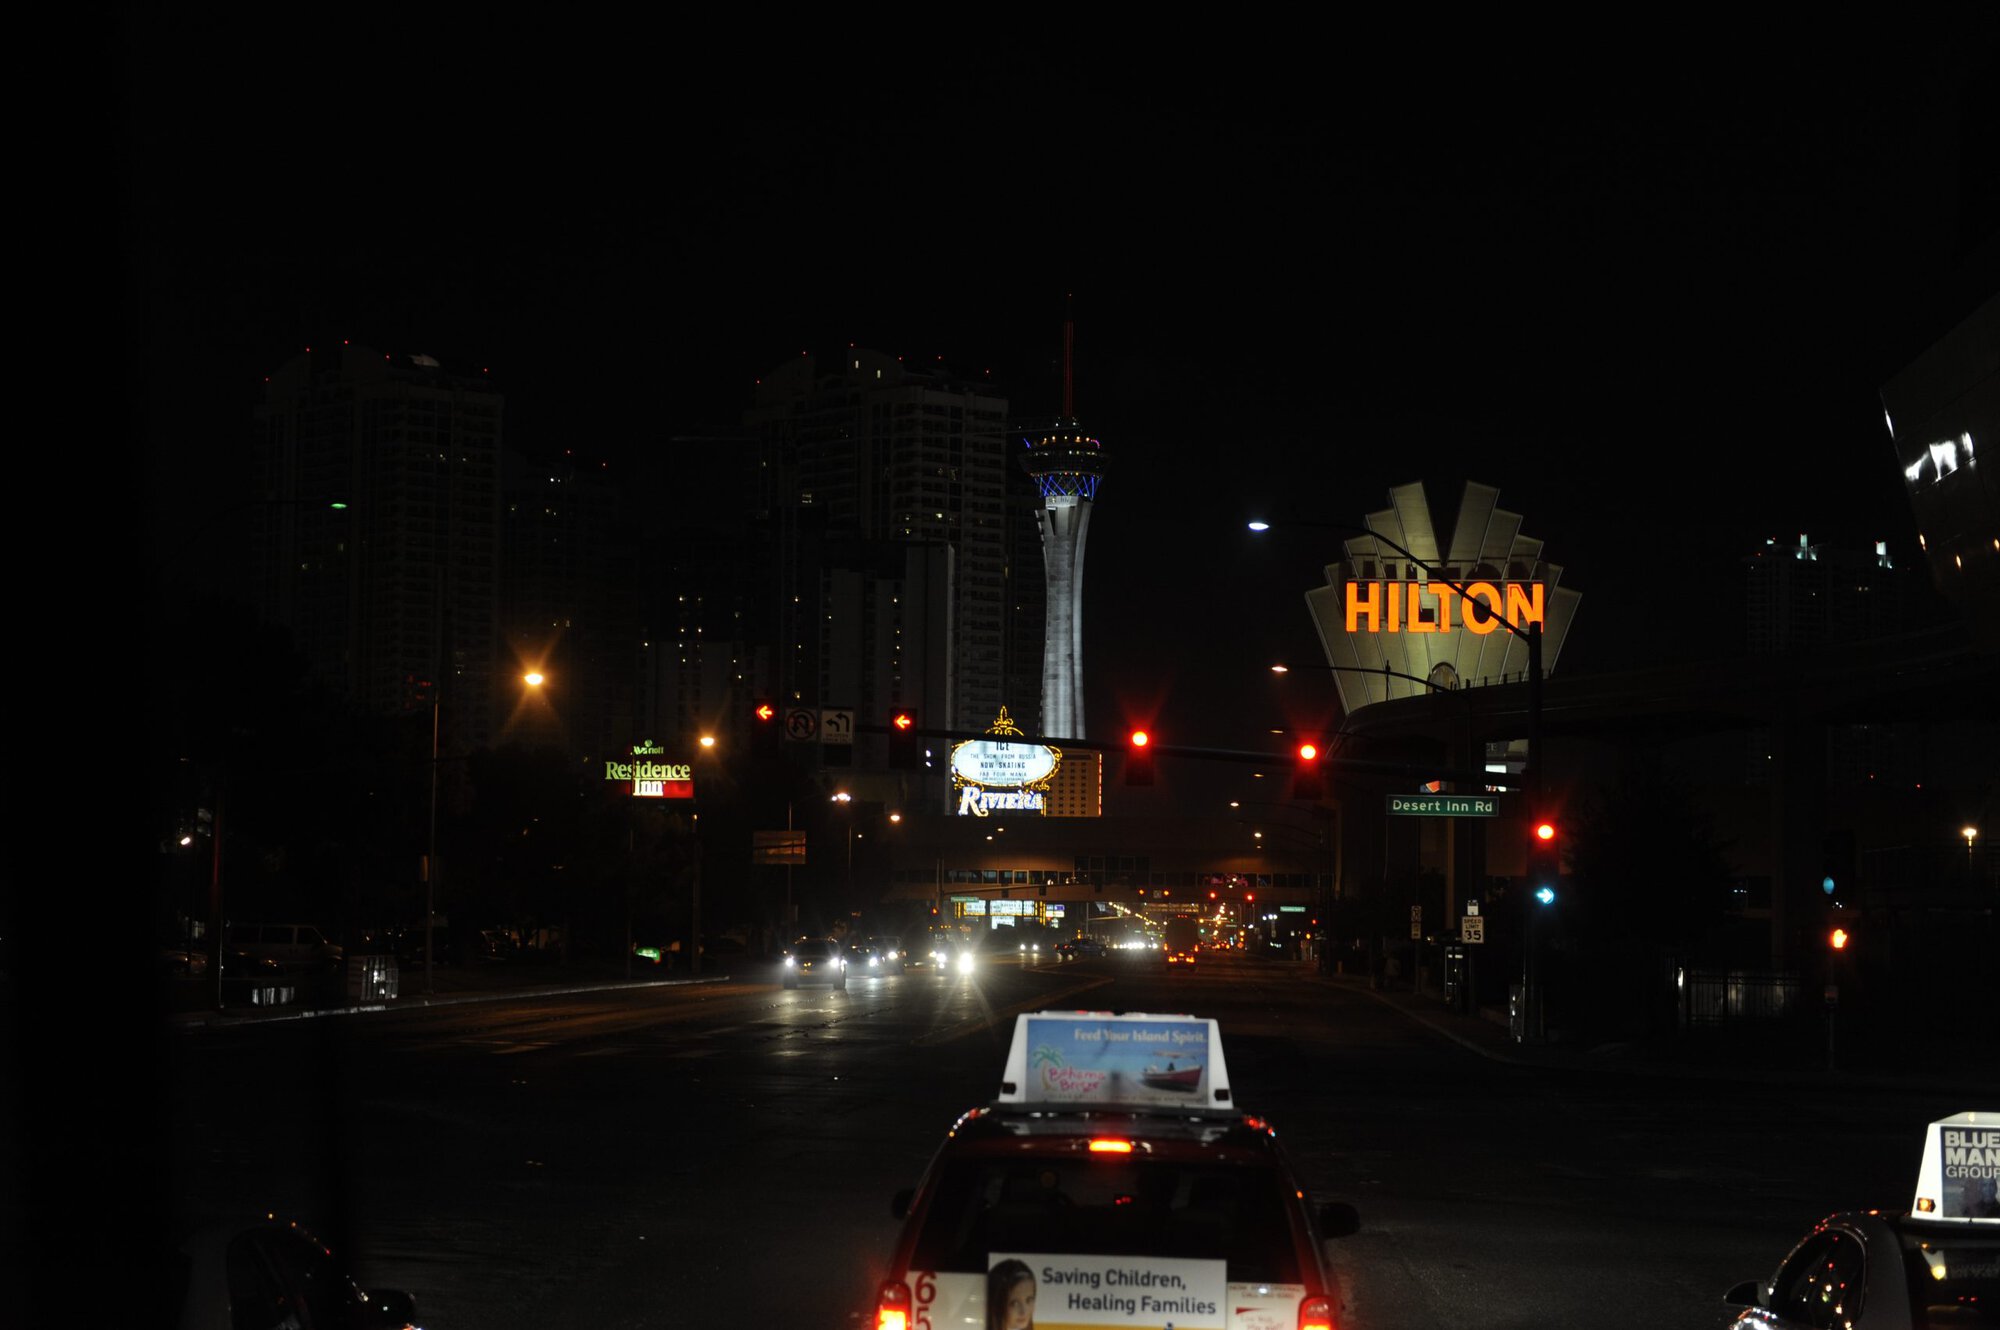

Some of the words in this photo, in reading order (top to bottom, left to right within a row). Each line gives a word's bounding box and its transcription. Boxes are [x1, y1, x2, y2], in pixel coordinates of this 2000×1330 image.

[1345, 581, 1544, 635] HILTON
[605, 761, 691, 780] Residence
[998, 761, 1026, 769] SKATING
[633, 778, 664, 796] Inn
[1393, 800, 1440, 811] Desert
[1447, 801, 1469, 812] Inn
[1475, 801, 1493, 812] Rd
[1465, 930, 1481, 940] 35
[1074, 1029, 1101, 1040] Feed
[1104, 1030, 1129, 1042] Your
[1133, 1030, 1169, 1042] Island
[1945, 1131, 2000, 1148] BLUE
[1945, 1149, 2000, 1166] MAN
[1042, 1267, 1100, 1289] Saving
[1106, 1269, 1187, 1290] Children,
[1068, 1293, 1135, 1315] Healing
[1141, 1296, 1216, 1314] Families
